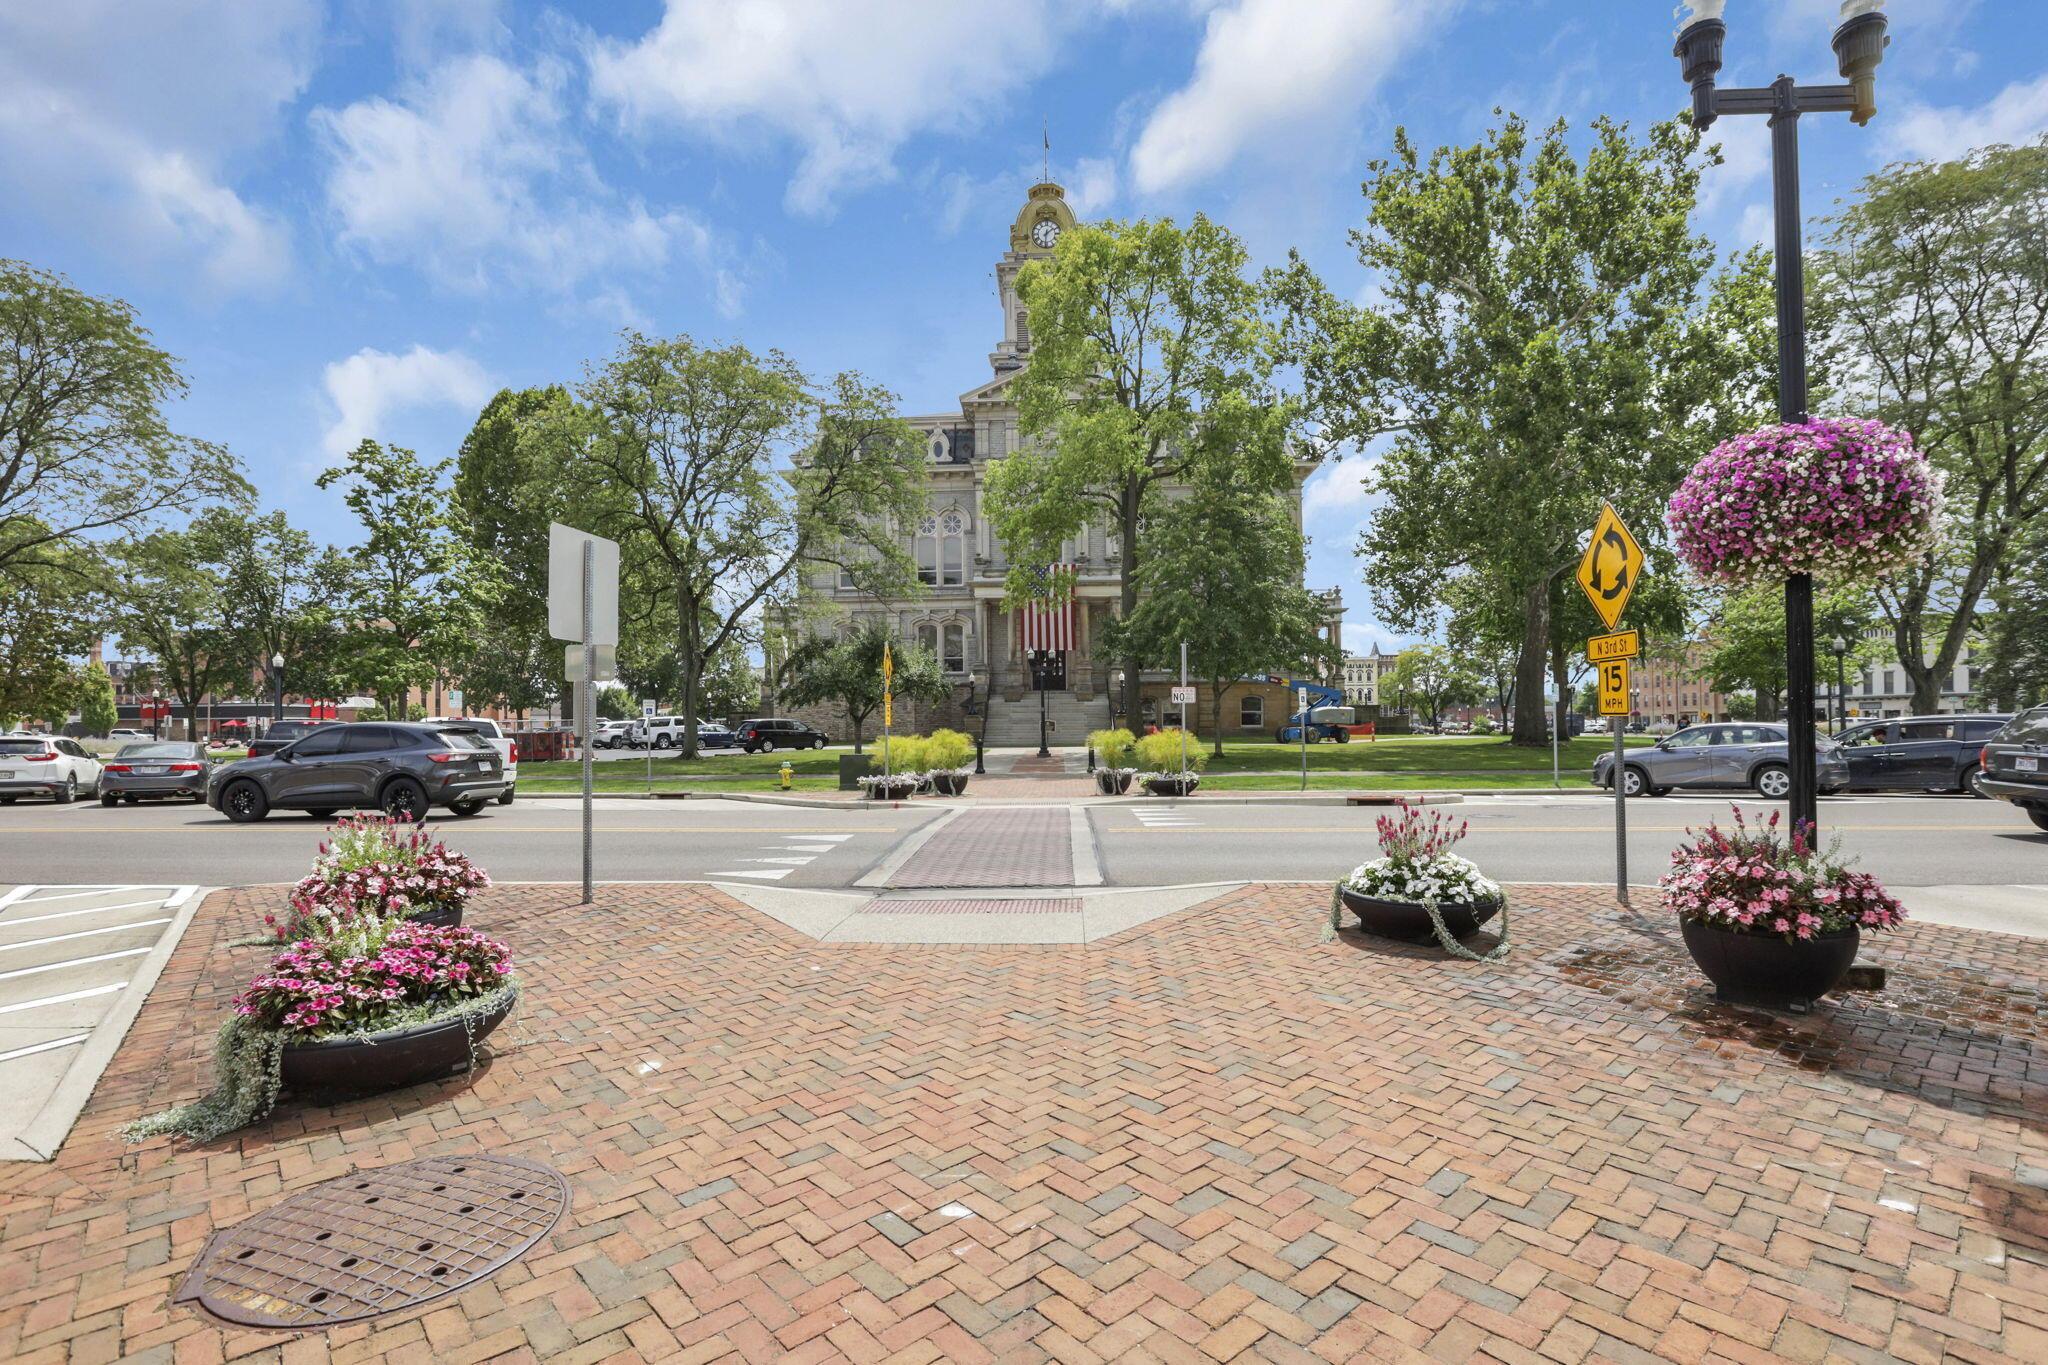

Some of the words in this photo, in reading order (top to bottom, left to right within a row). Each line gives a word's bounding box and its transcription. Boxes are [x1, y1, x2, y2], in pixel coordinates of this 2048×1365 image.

[1598, 642, 1603, 655] N
[1605, 641, 1617, 654] 3rd
[1620, 639, 1627, 652] St
[1604, 665, 1622, 692] 15
[1173, 693, 1185, 701] NO
[1605, 699, 1622, 708] MPH
